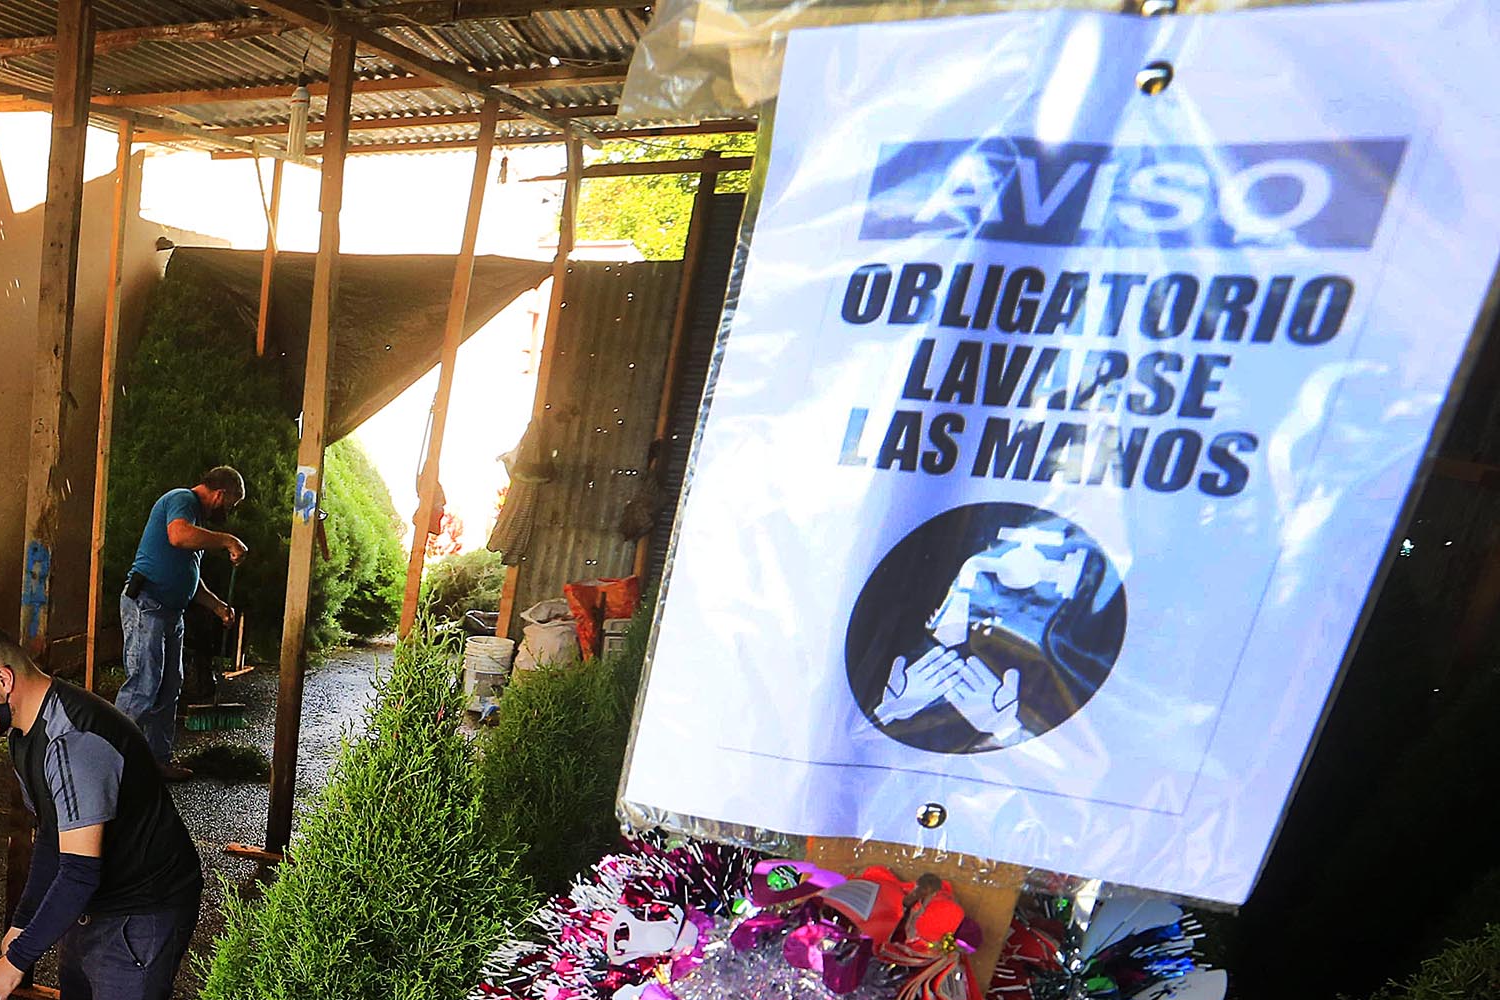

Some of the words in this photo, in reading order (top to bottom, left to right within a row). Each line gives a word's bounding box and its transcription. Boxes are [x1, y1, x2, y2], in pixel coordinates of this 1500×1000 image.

[913, 154, 1332, 238] AVISO
[840, 263, 1356, 346] OBLIGATORIO
[901, 338, 1232, 419] LAVARSE
[837, 408, 966, 476] LAS
[971, 415, 1259, 497] MANOS
